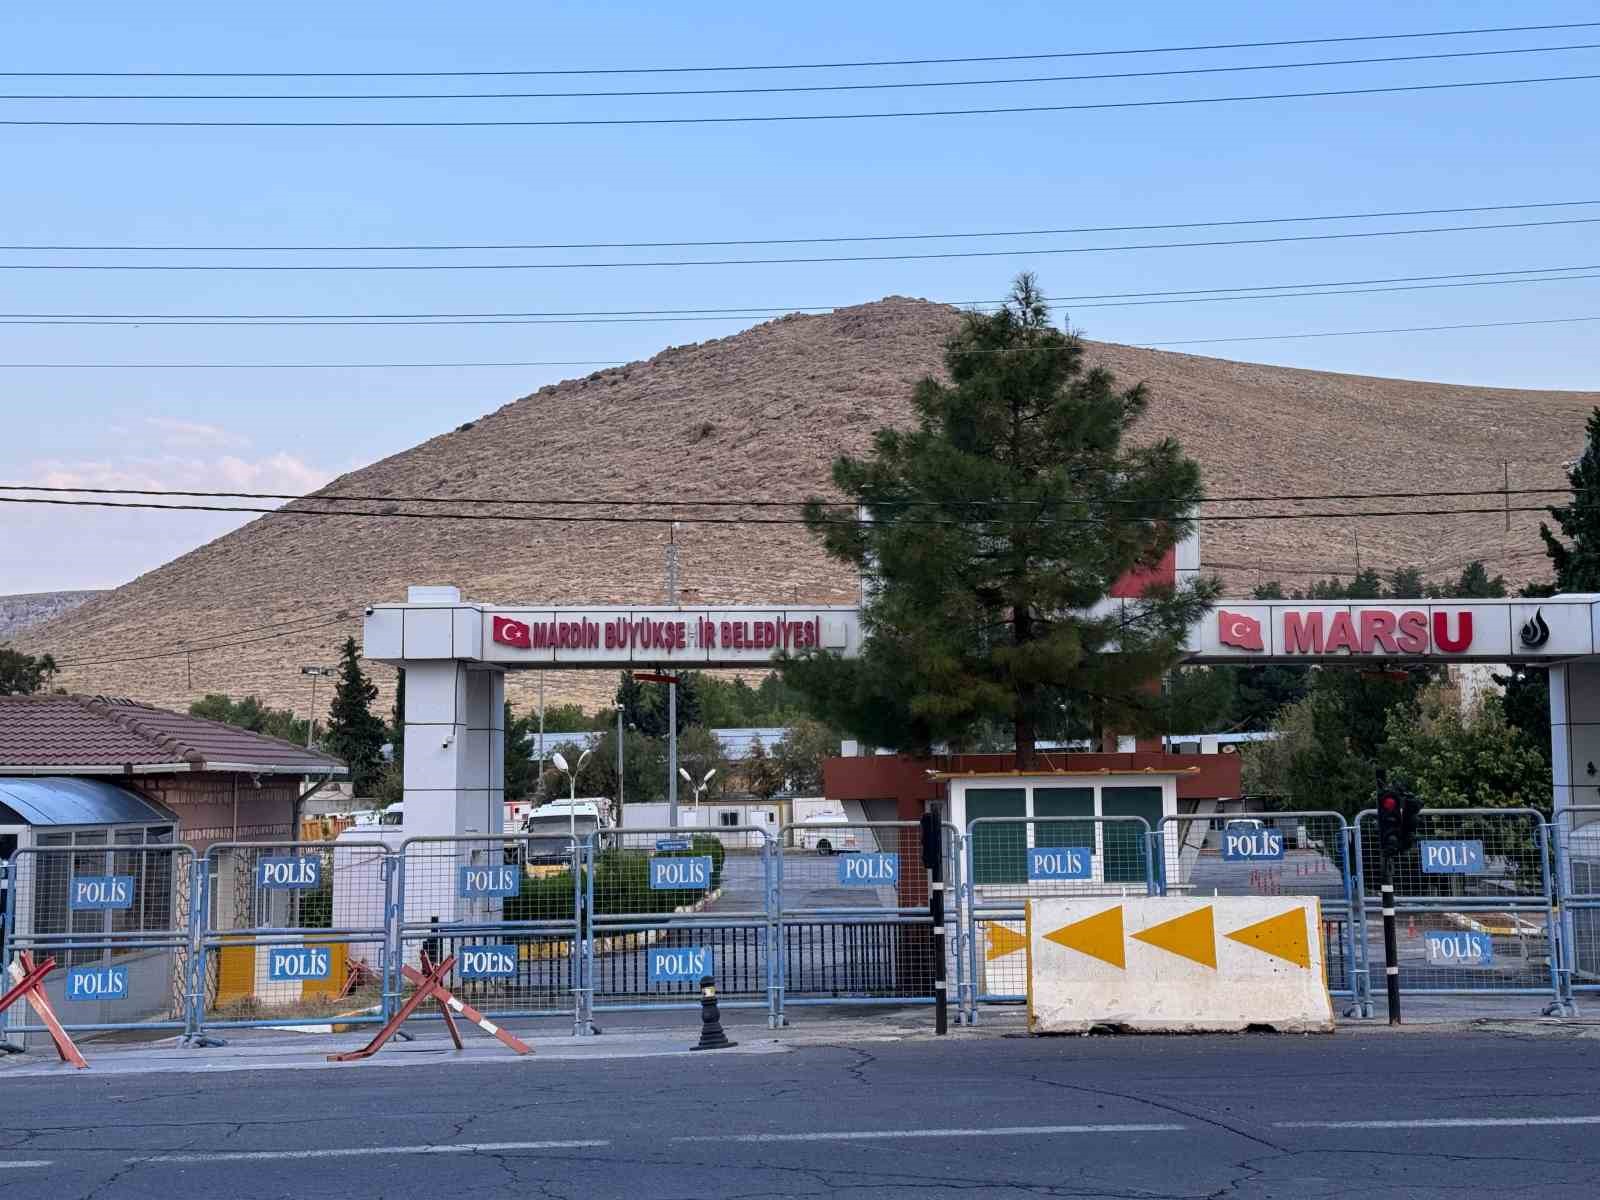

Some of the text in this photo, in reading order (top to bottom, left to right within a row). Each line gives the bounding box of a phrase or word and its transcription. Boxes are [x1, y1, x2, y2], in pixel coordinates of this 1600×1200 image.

[533, 616, 600, 649] MARDİN
[720, 615, 820, 649] BELEDİYESİ
[1283, 610, 1473, 653] MARSU
[1226, 831, 1281, 856] POLİS
[262, 858, 316, 885] POLİS
[656, 859, 704, 884] POLİS
[846, 856, 894, 880] POLİS
[1033, 850, 1082, 875] POLİS
[76, 877, 126, 904] POLİS
[466, 867, 514, 891] POLİS
[1430, 933, 1482, 959] POLİS
[274, 948, 328, 976] POLİS
[73, 968, 123, 995] POLİS
